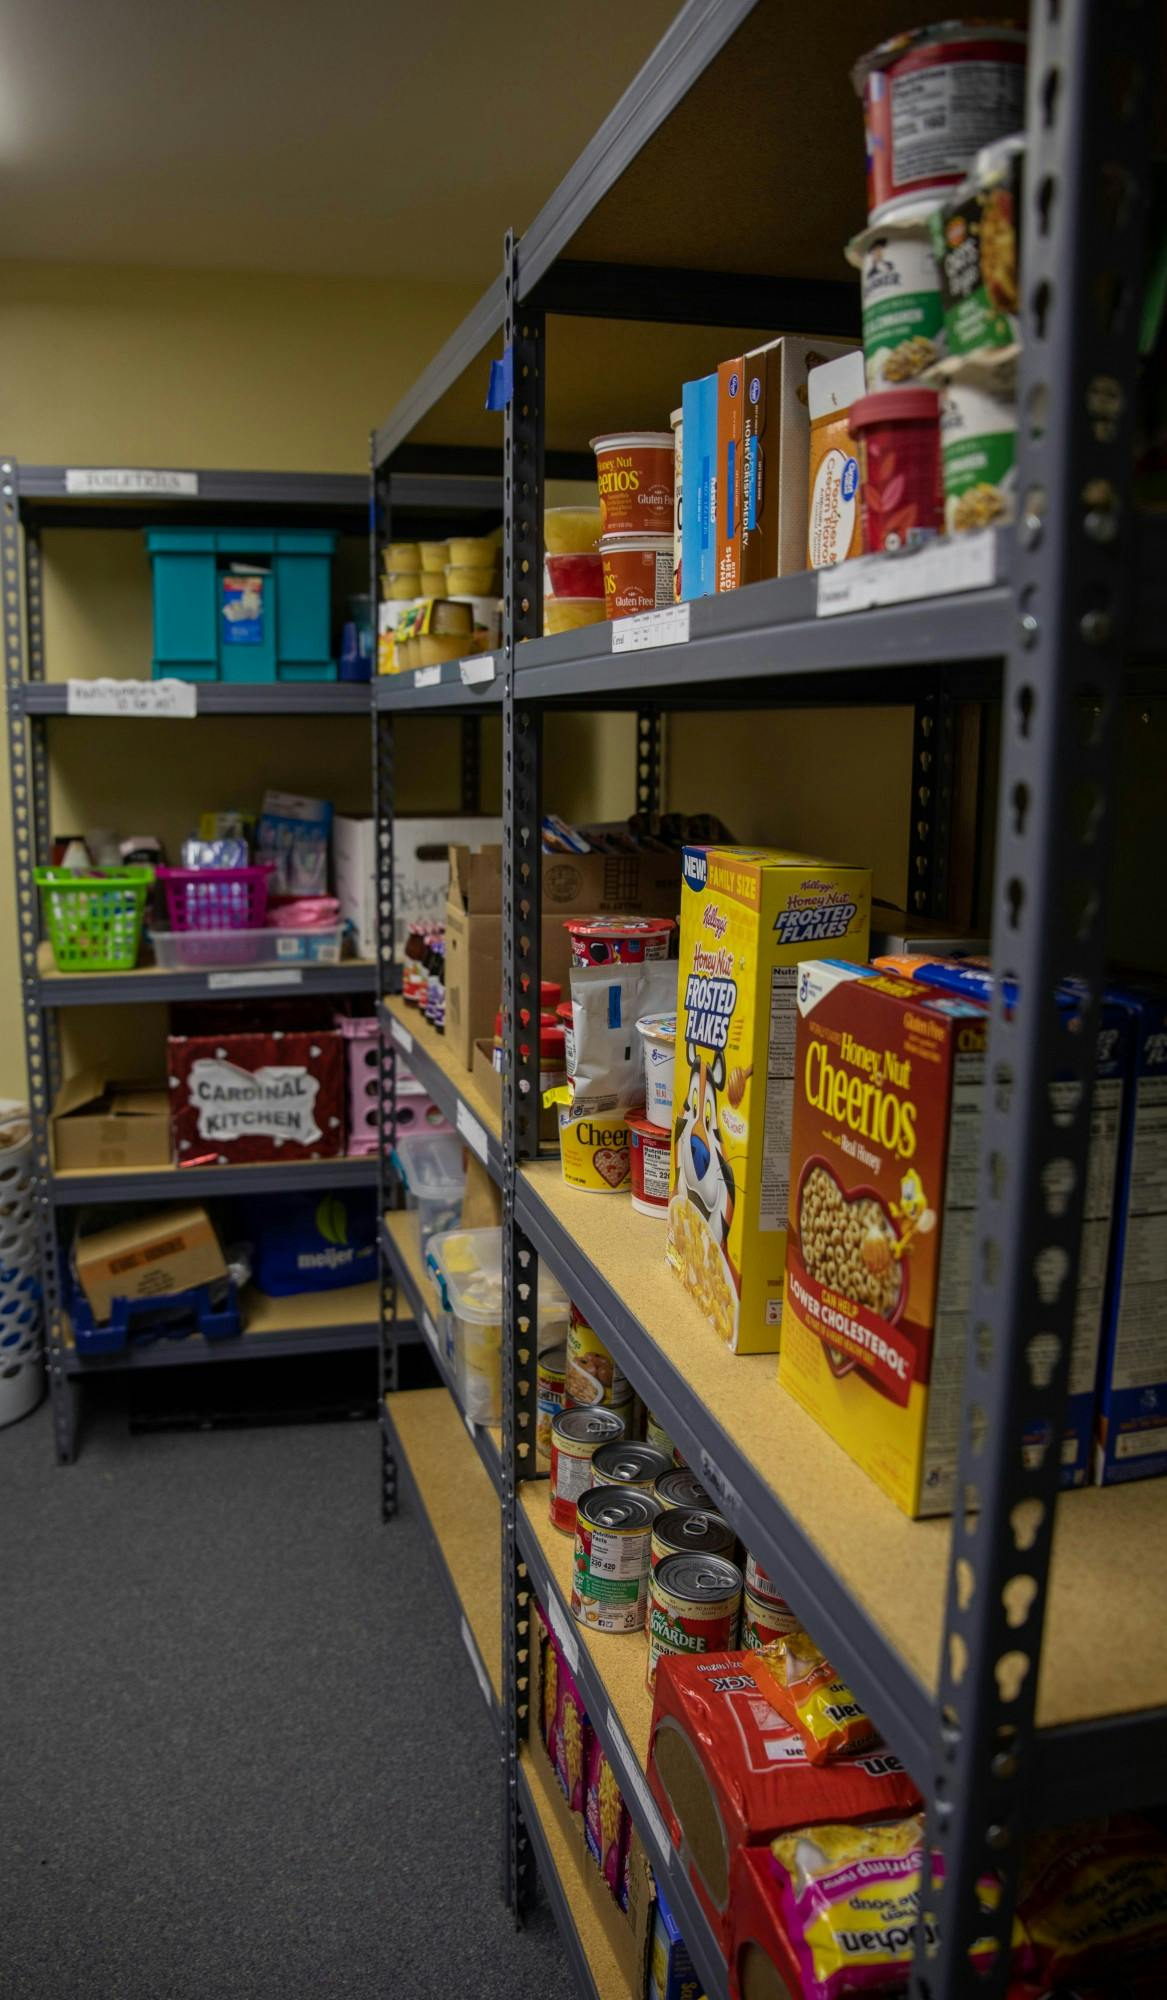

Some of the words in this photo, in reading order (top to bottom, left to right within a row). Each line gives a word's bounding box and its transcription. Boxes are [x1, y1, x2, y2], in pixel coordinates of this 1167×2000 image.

[616, 456, 632, 468] Nut
[824, 458, 836, 513] Cream
[637, 494, 663, 505] Gluten
[742, 500, 750, 546] MEDLEY
[830, 479, 841, 547] Peaches
[822, 517, 832, 565] Flavor
[616, 597, 637, 606] Gluten
[639, 597, 654, 606] Free
[684, 854, 707, 882] NEW!
[709, 865, 735, 892] FAMILY
[736, 873, 757, 900] SIZE
[787, 894, 825, 909] Honey
[825, 892, 849, 905] Nut
[775, 905, 856, 928] FROSTED
[780, 920, 848, 943] FLAKES
[693, 943, 716, 975] Honey
[716, 948, 733, 976] Nut
[685, 978, 737, 1016] FROSTED
[686, 1010, 730, 1049] FLAKES
[840, 1032, 882, 1082] Honey
[882, 1050, 912, 1090] Nut
[198, 1077, 307, 1101] CARDINAL
[805, 1041, 917, 1158] Cheerios
[206, 1110, 301, 1134] KITCHEN
[841, 1134, 857, 1158] Real
[857, 1142, 882, 1176] Honey
[298, 1249, 352, 1270] meijer
[821, 1289, 836, 1307] CAN
[837, 1297, 860, 1318] HELP
[790, 1272, 821, 1320] LOWER
[821, 1304, 907, 1381] CHOLESTEROL
[592, 1529, 618, 1540] Nutrition
[592, 1534, 607, 1544] Facts
[591, 1559, 602, 1568] 230
[603, 1562, 616, 1571] 420
[651, 1609, 666, 1624] Chef
[856, 1851, 923, 1882] Shrimp
[849, 1897, 894, 1913] Soup
